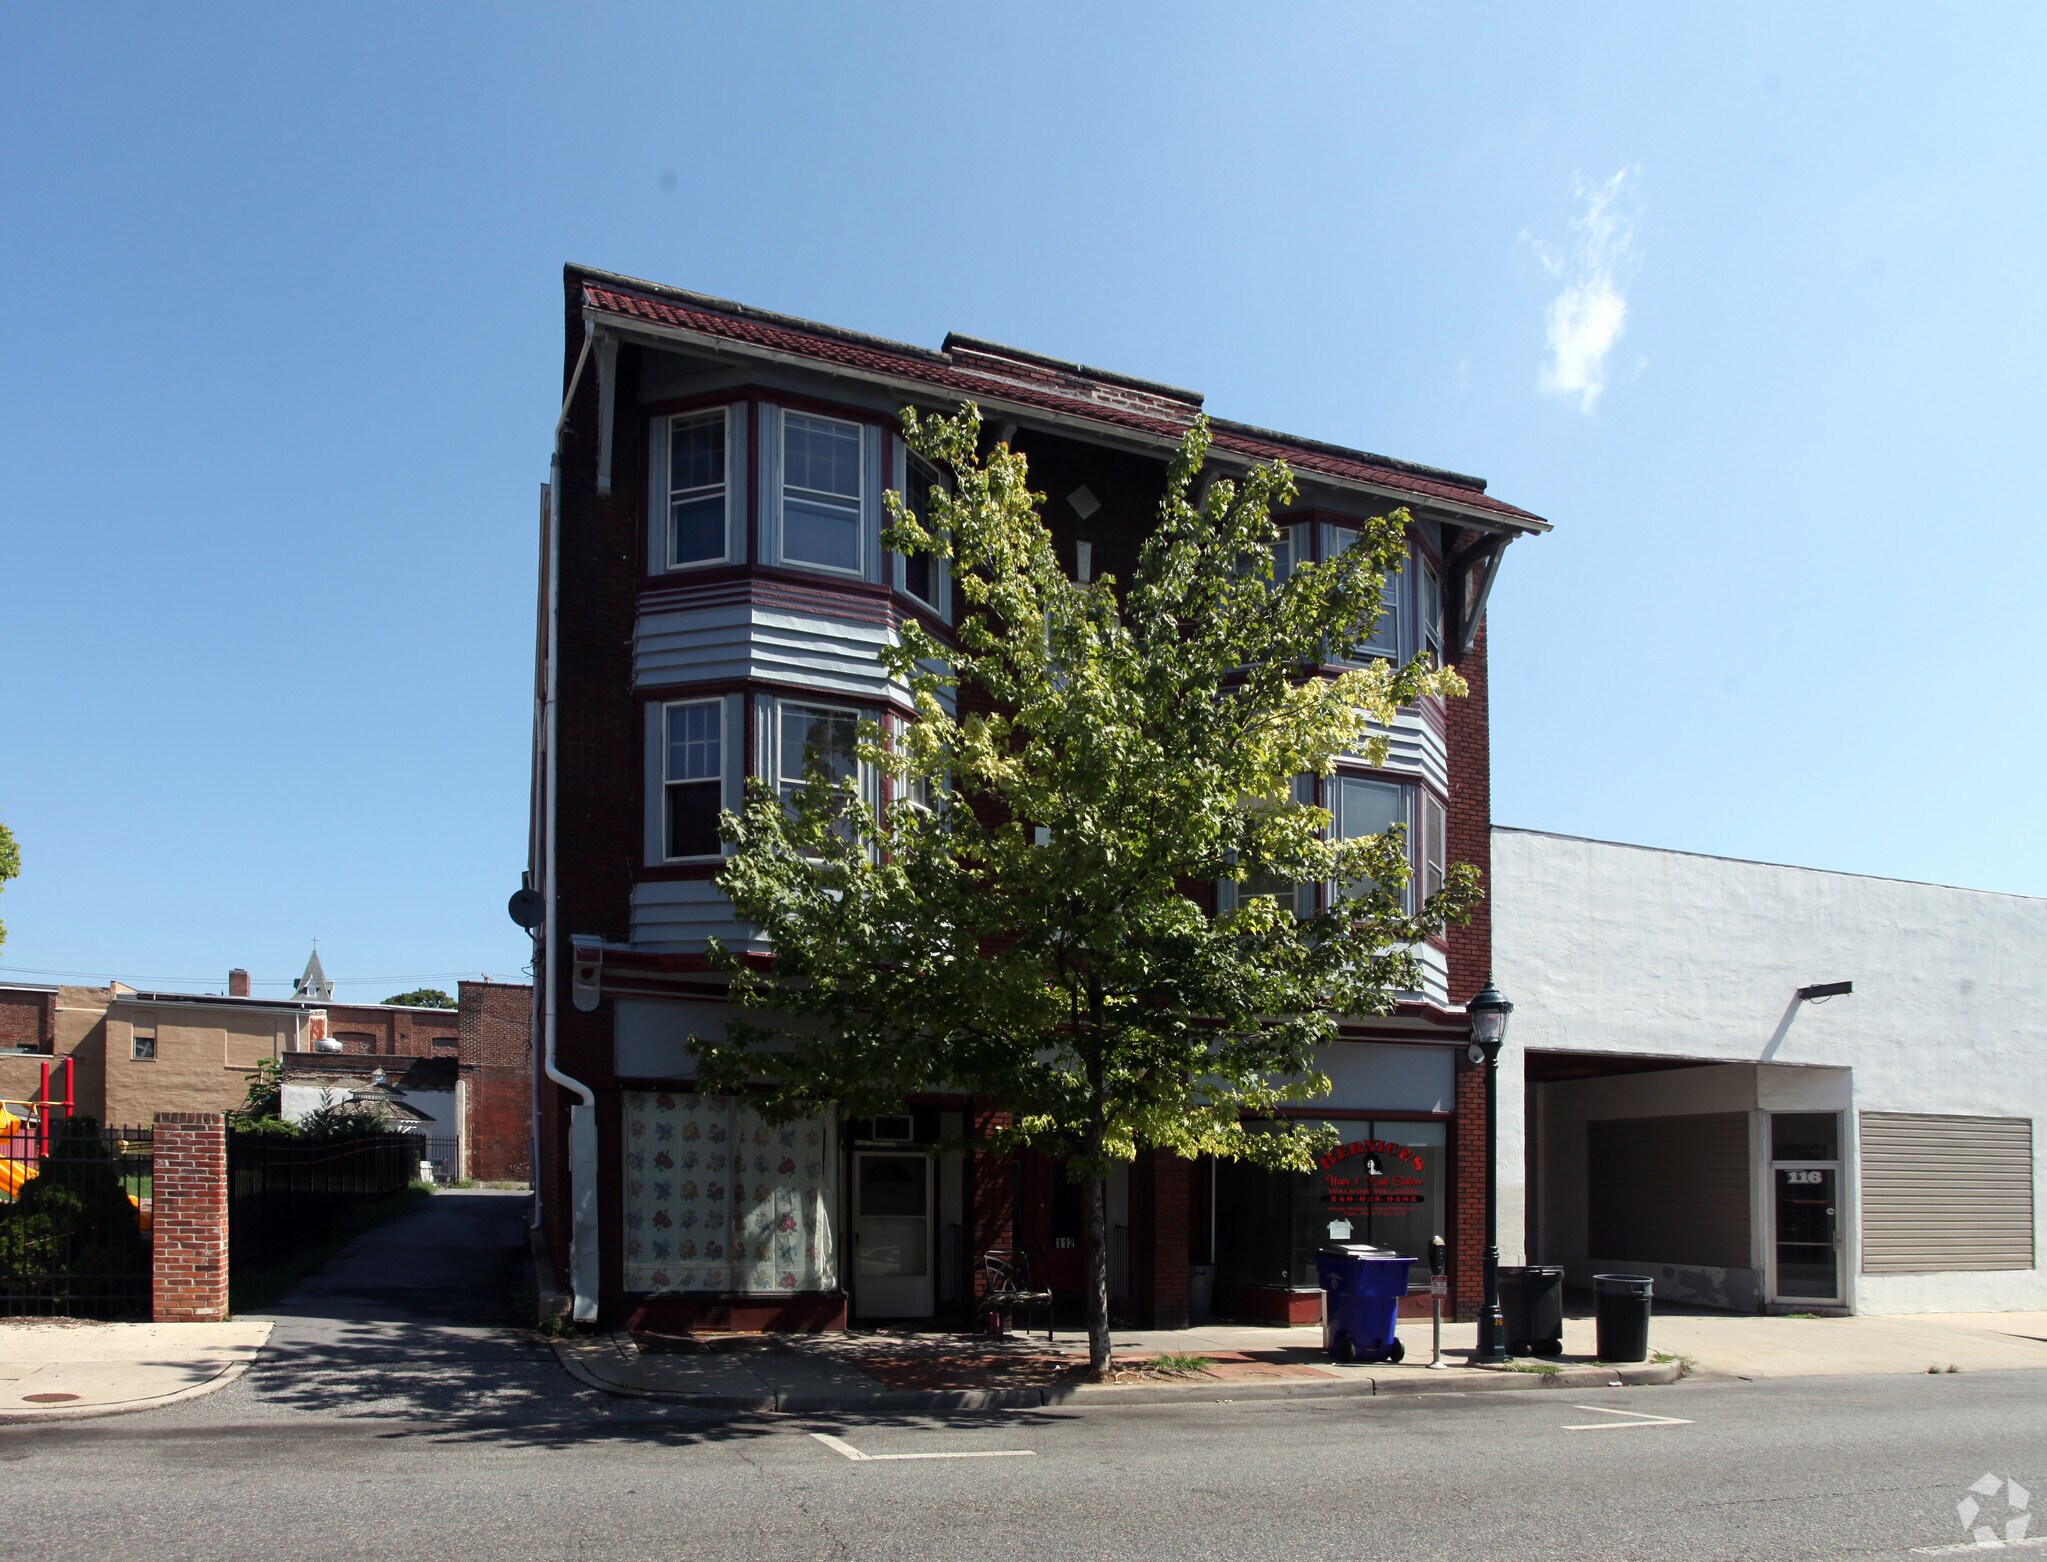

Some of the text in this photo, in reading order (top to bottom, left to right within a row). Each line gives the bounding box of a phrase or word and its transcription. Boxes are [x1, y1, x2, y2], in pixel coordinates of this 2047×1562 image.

[1391, 1175, 1425, 1187] Salon
[1787, 1171, 1823, 1184] 116
[1057, 1237, 1075, 1248] 112
[1495, 1318, 1503, 1326] 26
